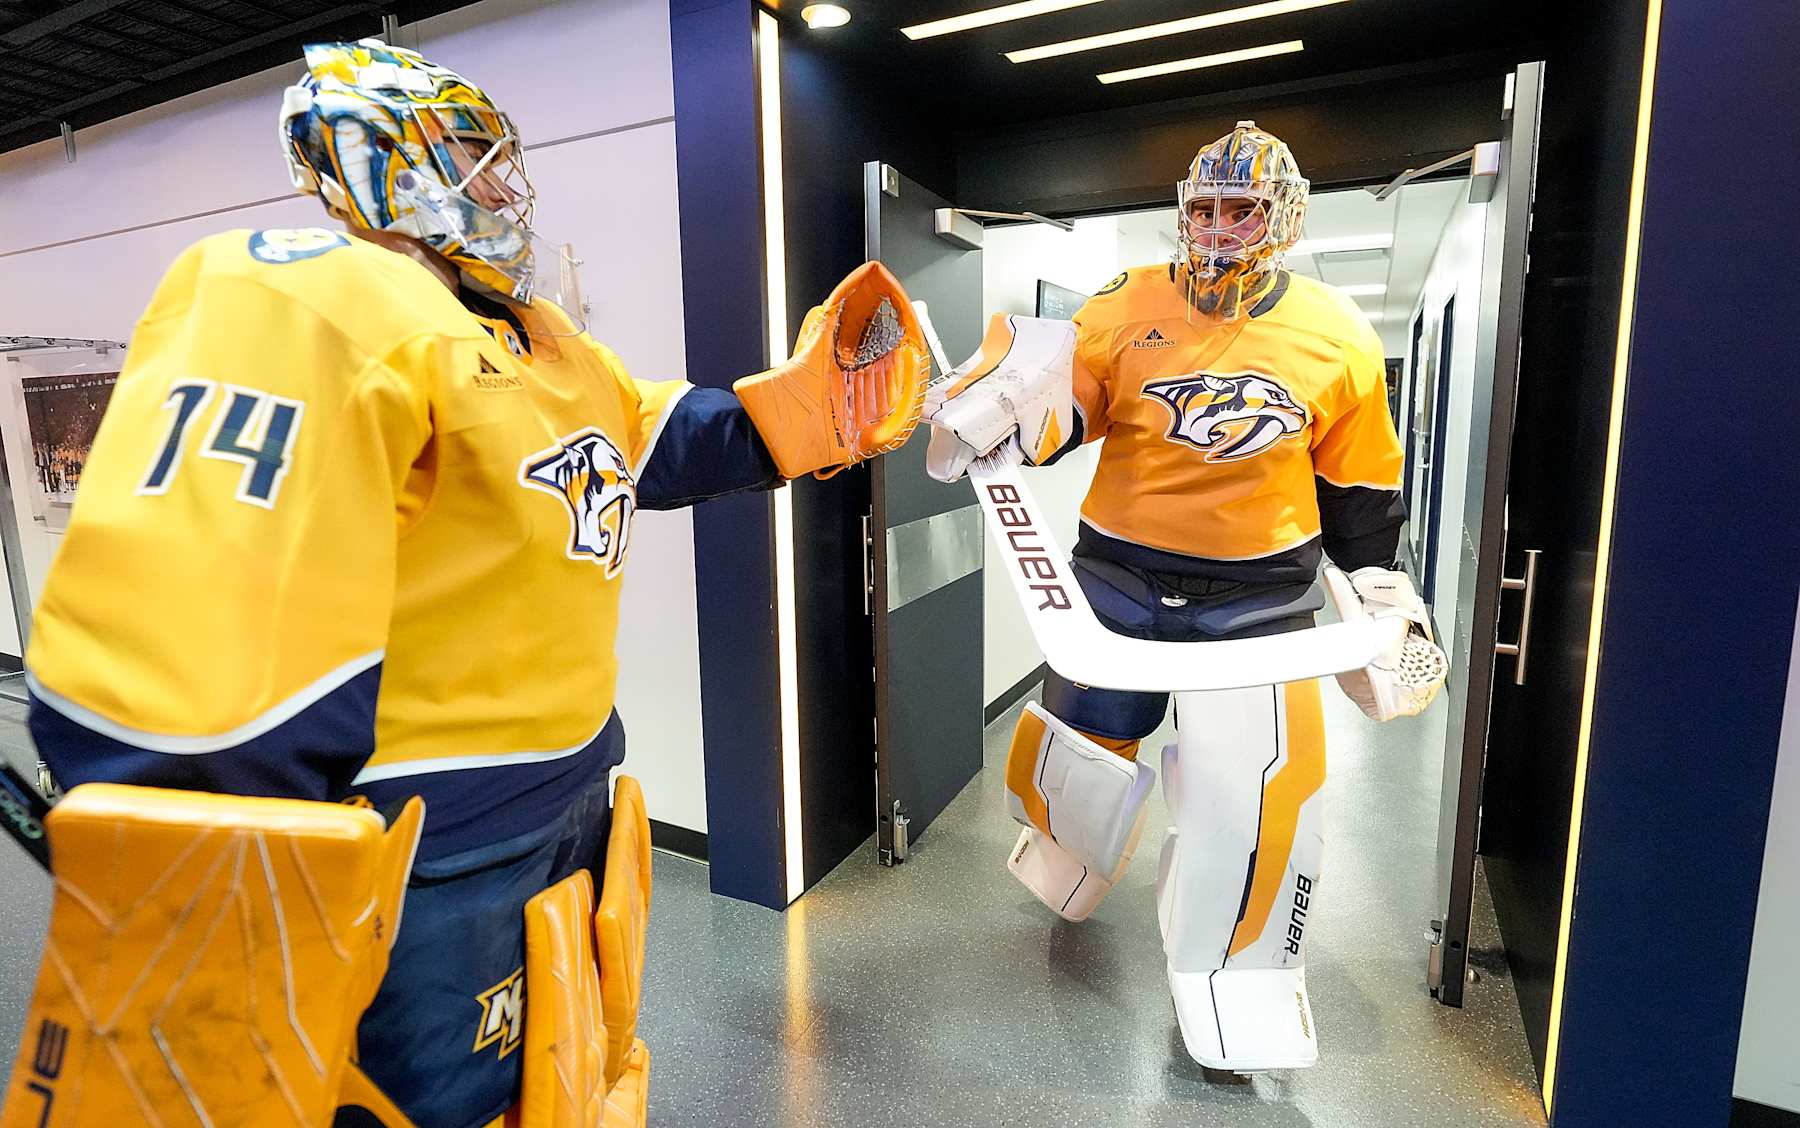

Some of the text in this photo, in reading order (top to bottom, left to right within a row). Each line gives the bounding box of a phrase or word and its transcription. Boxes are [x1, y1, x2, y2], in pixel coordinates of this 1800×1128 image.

[471, 374, 523, 390] REGIONS
[1133, 339, 1175, 349] REGIONS
[134, 377, 306, 511] 14
[986, 484, 1072, 611] BAUER
[1284, 873, 1312, 956] BAUER
